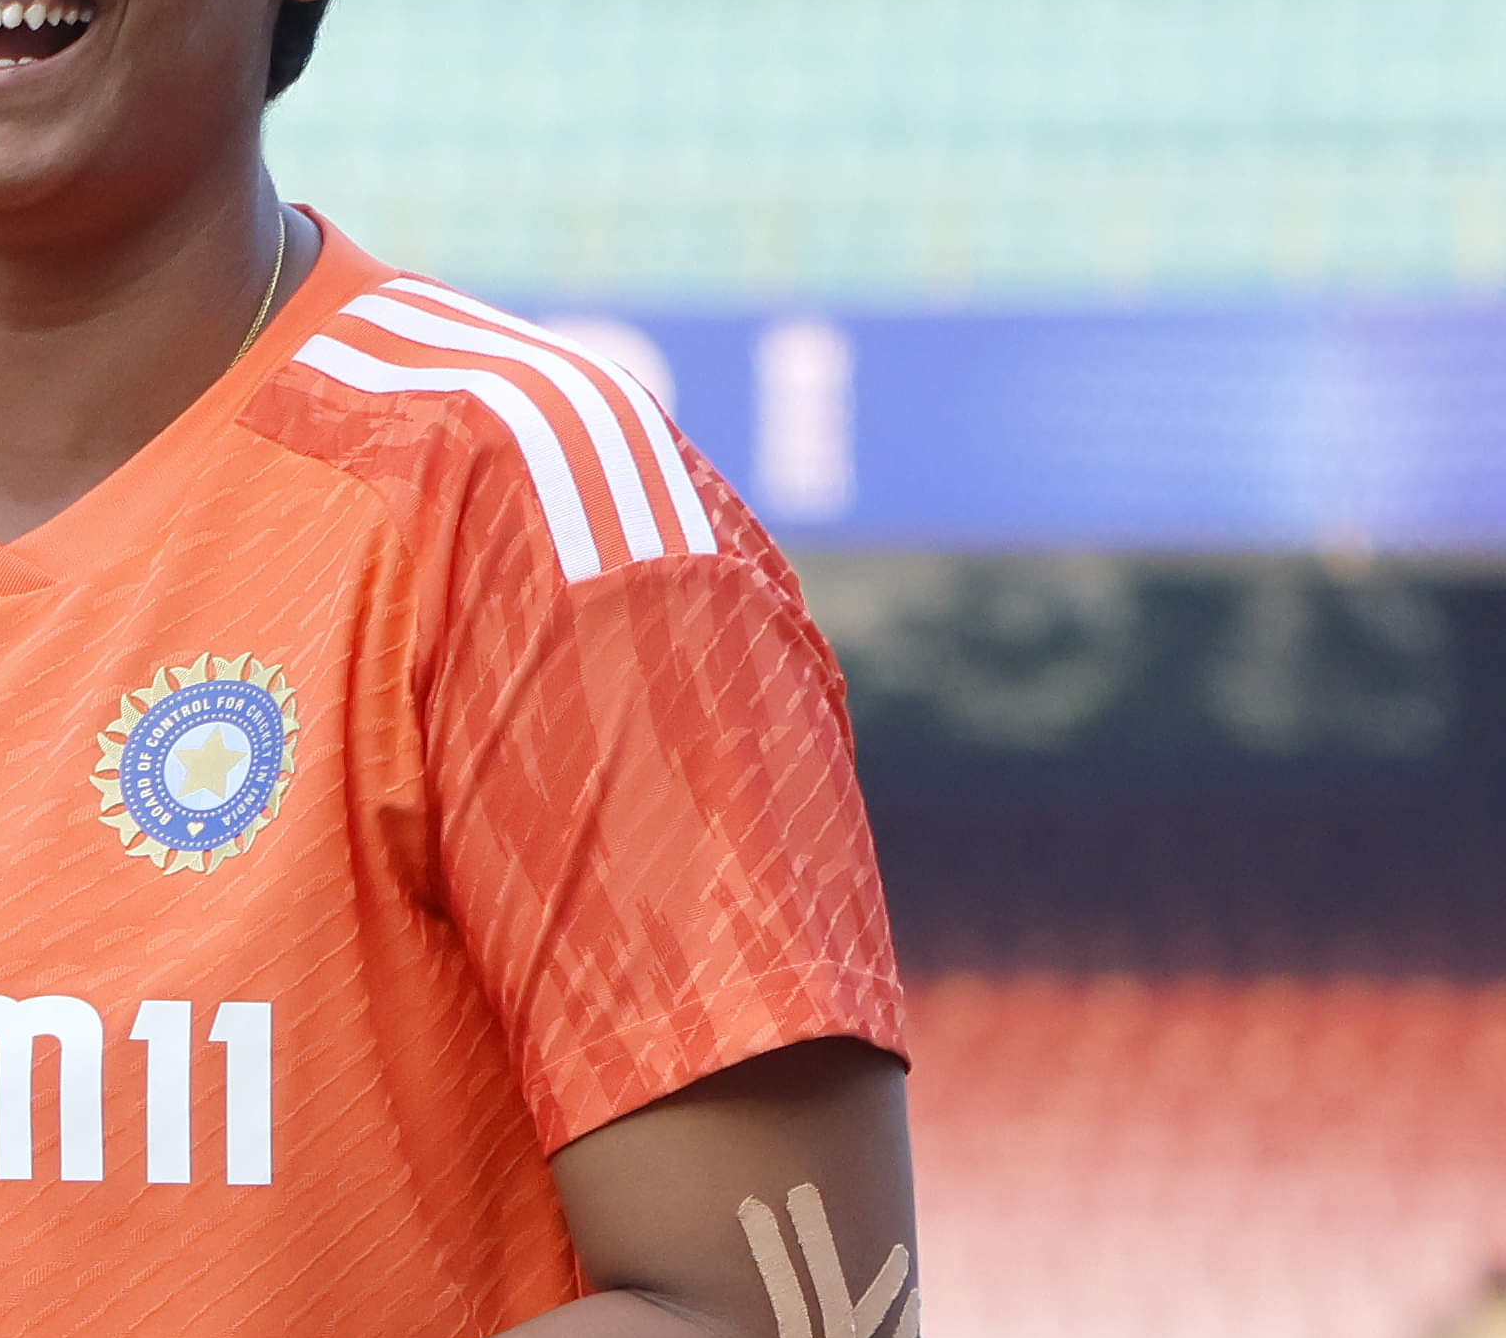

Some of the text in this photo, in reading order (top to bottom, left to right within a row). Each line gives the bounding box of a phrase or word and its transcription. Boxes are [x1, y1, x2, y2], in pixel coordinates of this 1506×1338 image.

[137, 696, 273, 826] BOARD OF CONTROL FOR CRICKET IN INDIA
